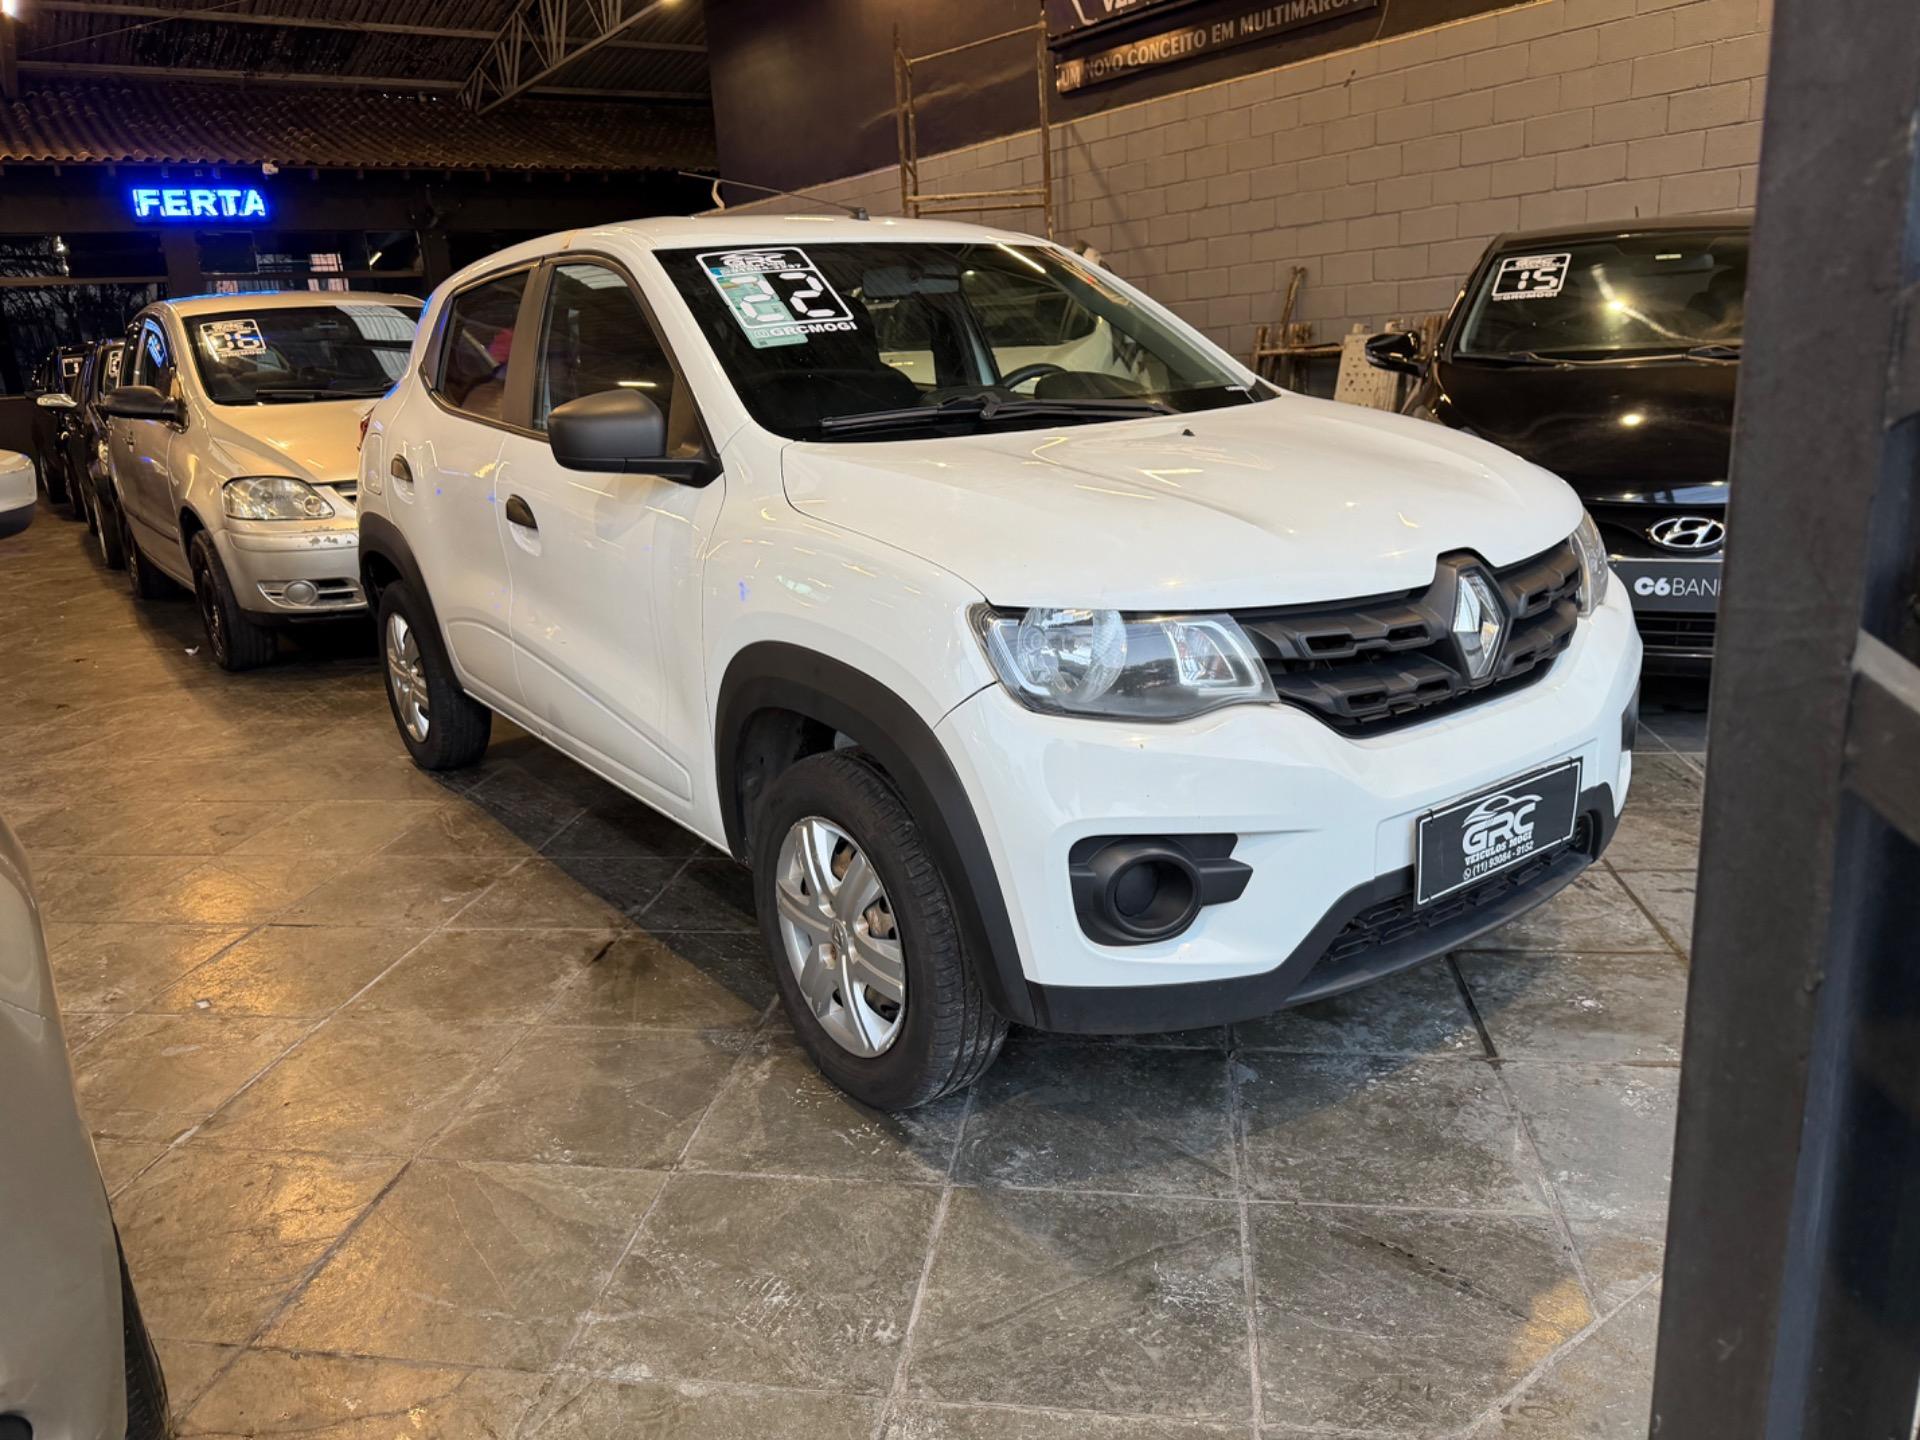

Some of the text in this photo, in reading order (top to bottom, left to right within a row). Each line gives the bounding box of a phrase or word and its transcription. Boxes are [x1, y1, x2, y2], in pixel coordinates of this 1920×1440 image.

[1085, 54, 1123, 79] NOVO
[1127, 30, 1206, 65] CONCEITO
[1212, 20, 1234, 43] EM
[1240, 0, 1358, 34] MULTIMAR
[731, 273, 835, 320] 22
[754, 322, 857, 337] @GRCMOGI
[1463, 802, 1536, 855] GRC
[1465, 832, 1532, 865] VEICULOS MOGI
[1472, 861, 1488, 875] (11)
[1517, 841, 1534, 856] 9152
